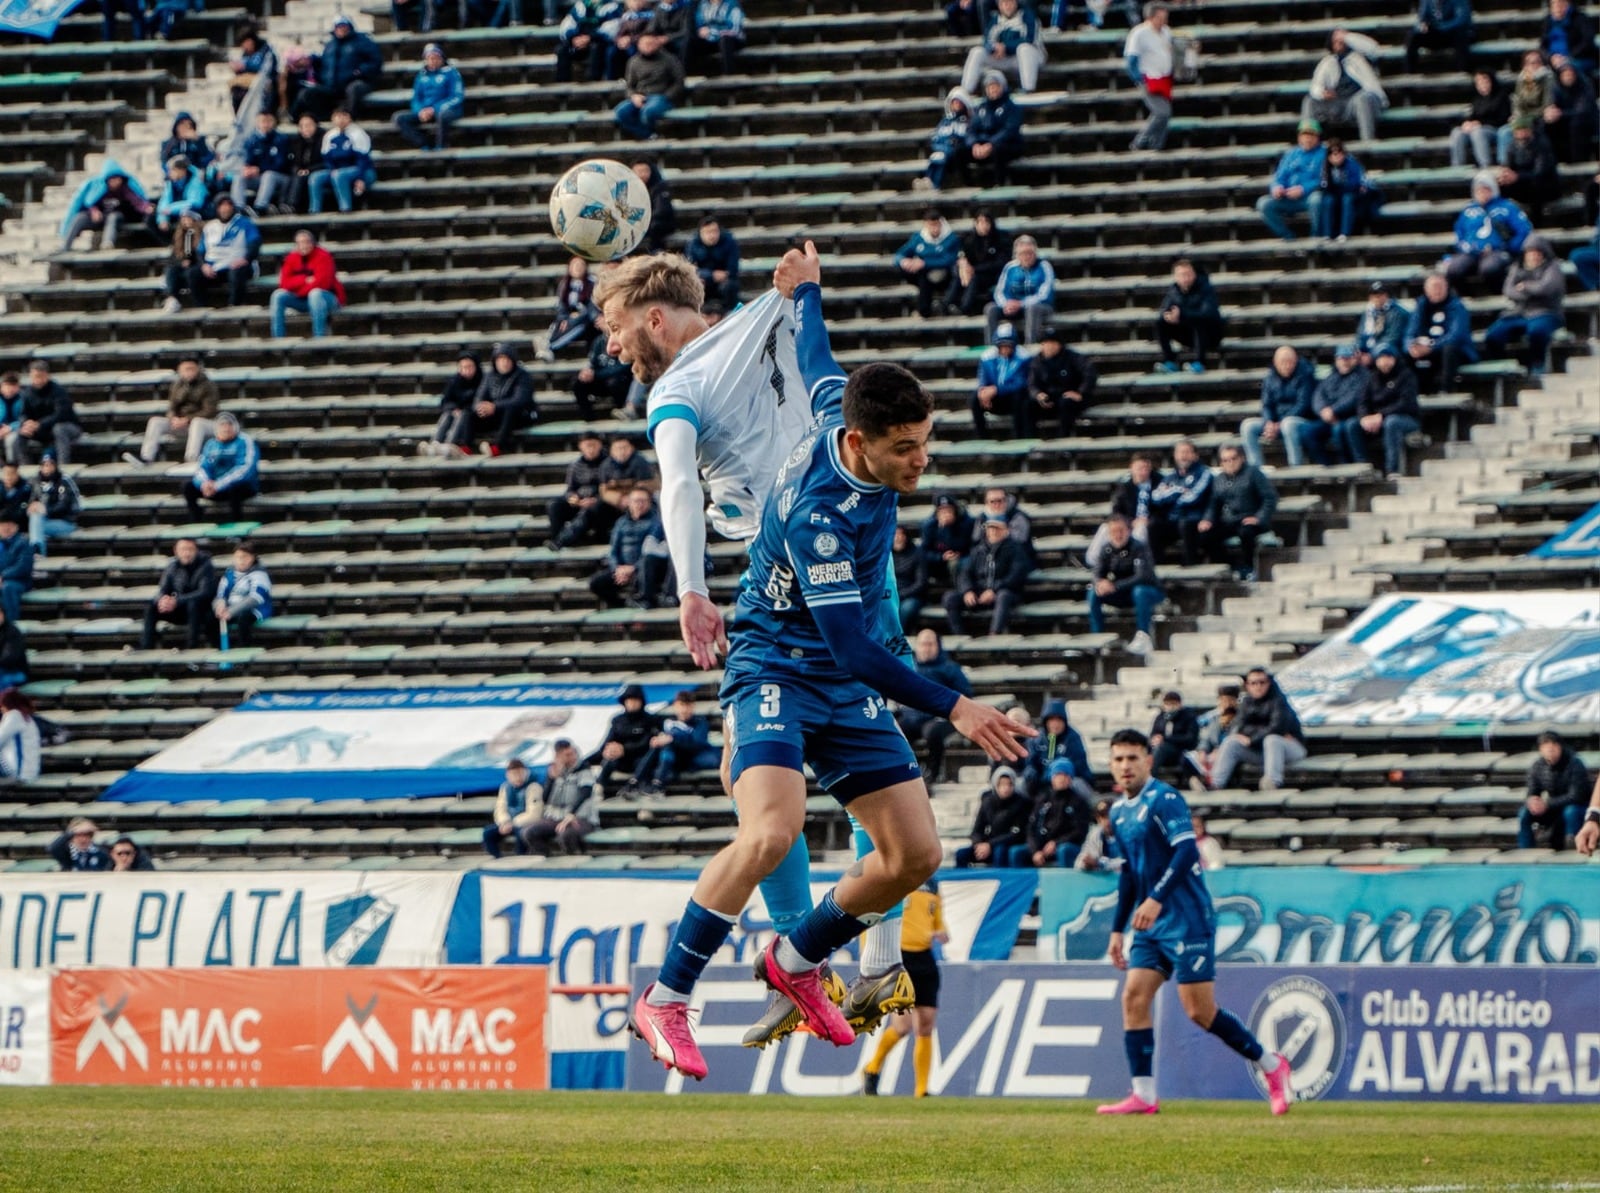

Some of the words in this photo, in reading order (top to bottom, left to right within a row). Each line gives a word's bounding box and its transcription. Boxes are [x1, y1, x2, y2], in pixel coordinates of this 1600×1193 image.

[759, 683, 782, 719] 3
[131, 888, 304, 967] PLATA
[0, 1006, 25, 1049] R
[1361, 988, 1431, 1027] Club
[1433, 989, 1553, 1028] Atlético
[160, 1007, 263, 1055] MAC
[410, 1008, 517, 1056] MAC
[160, 1059, 263, 1073] ALUMINIO
[411, 1060, 518, 1074] ALUMINIO
[1348, 1030, 1600, 1095] ALVARAD
